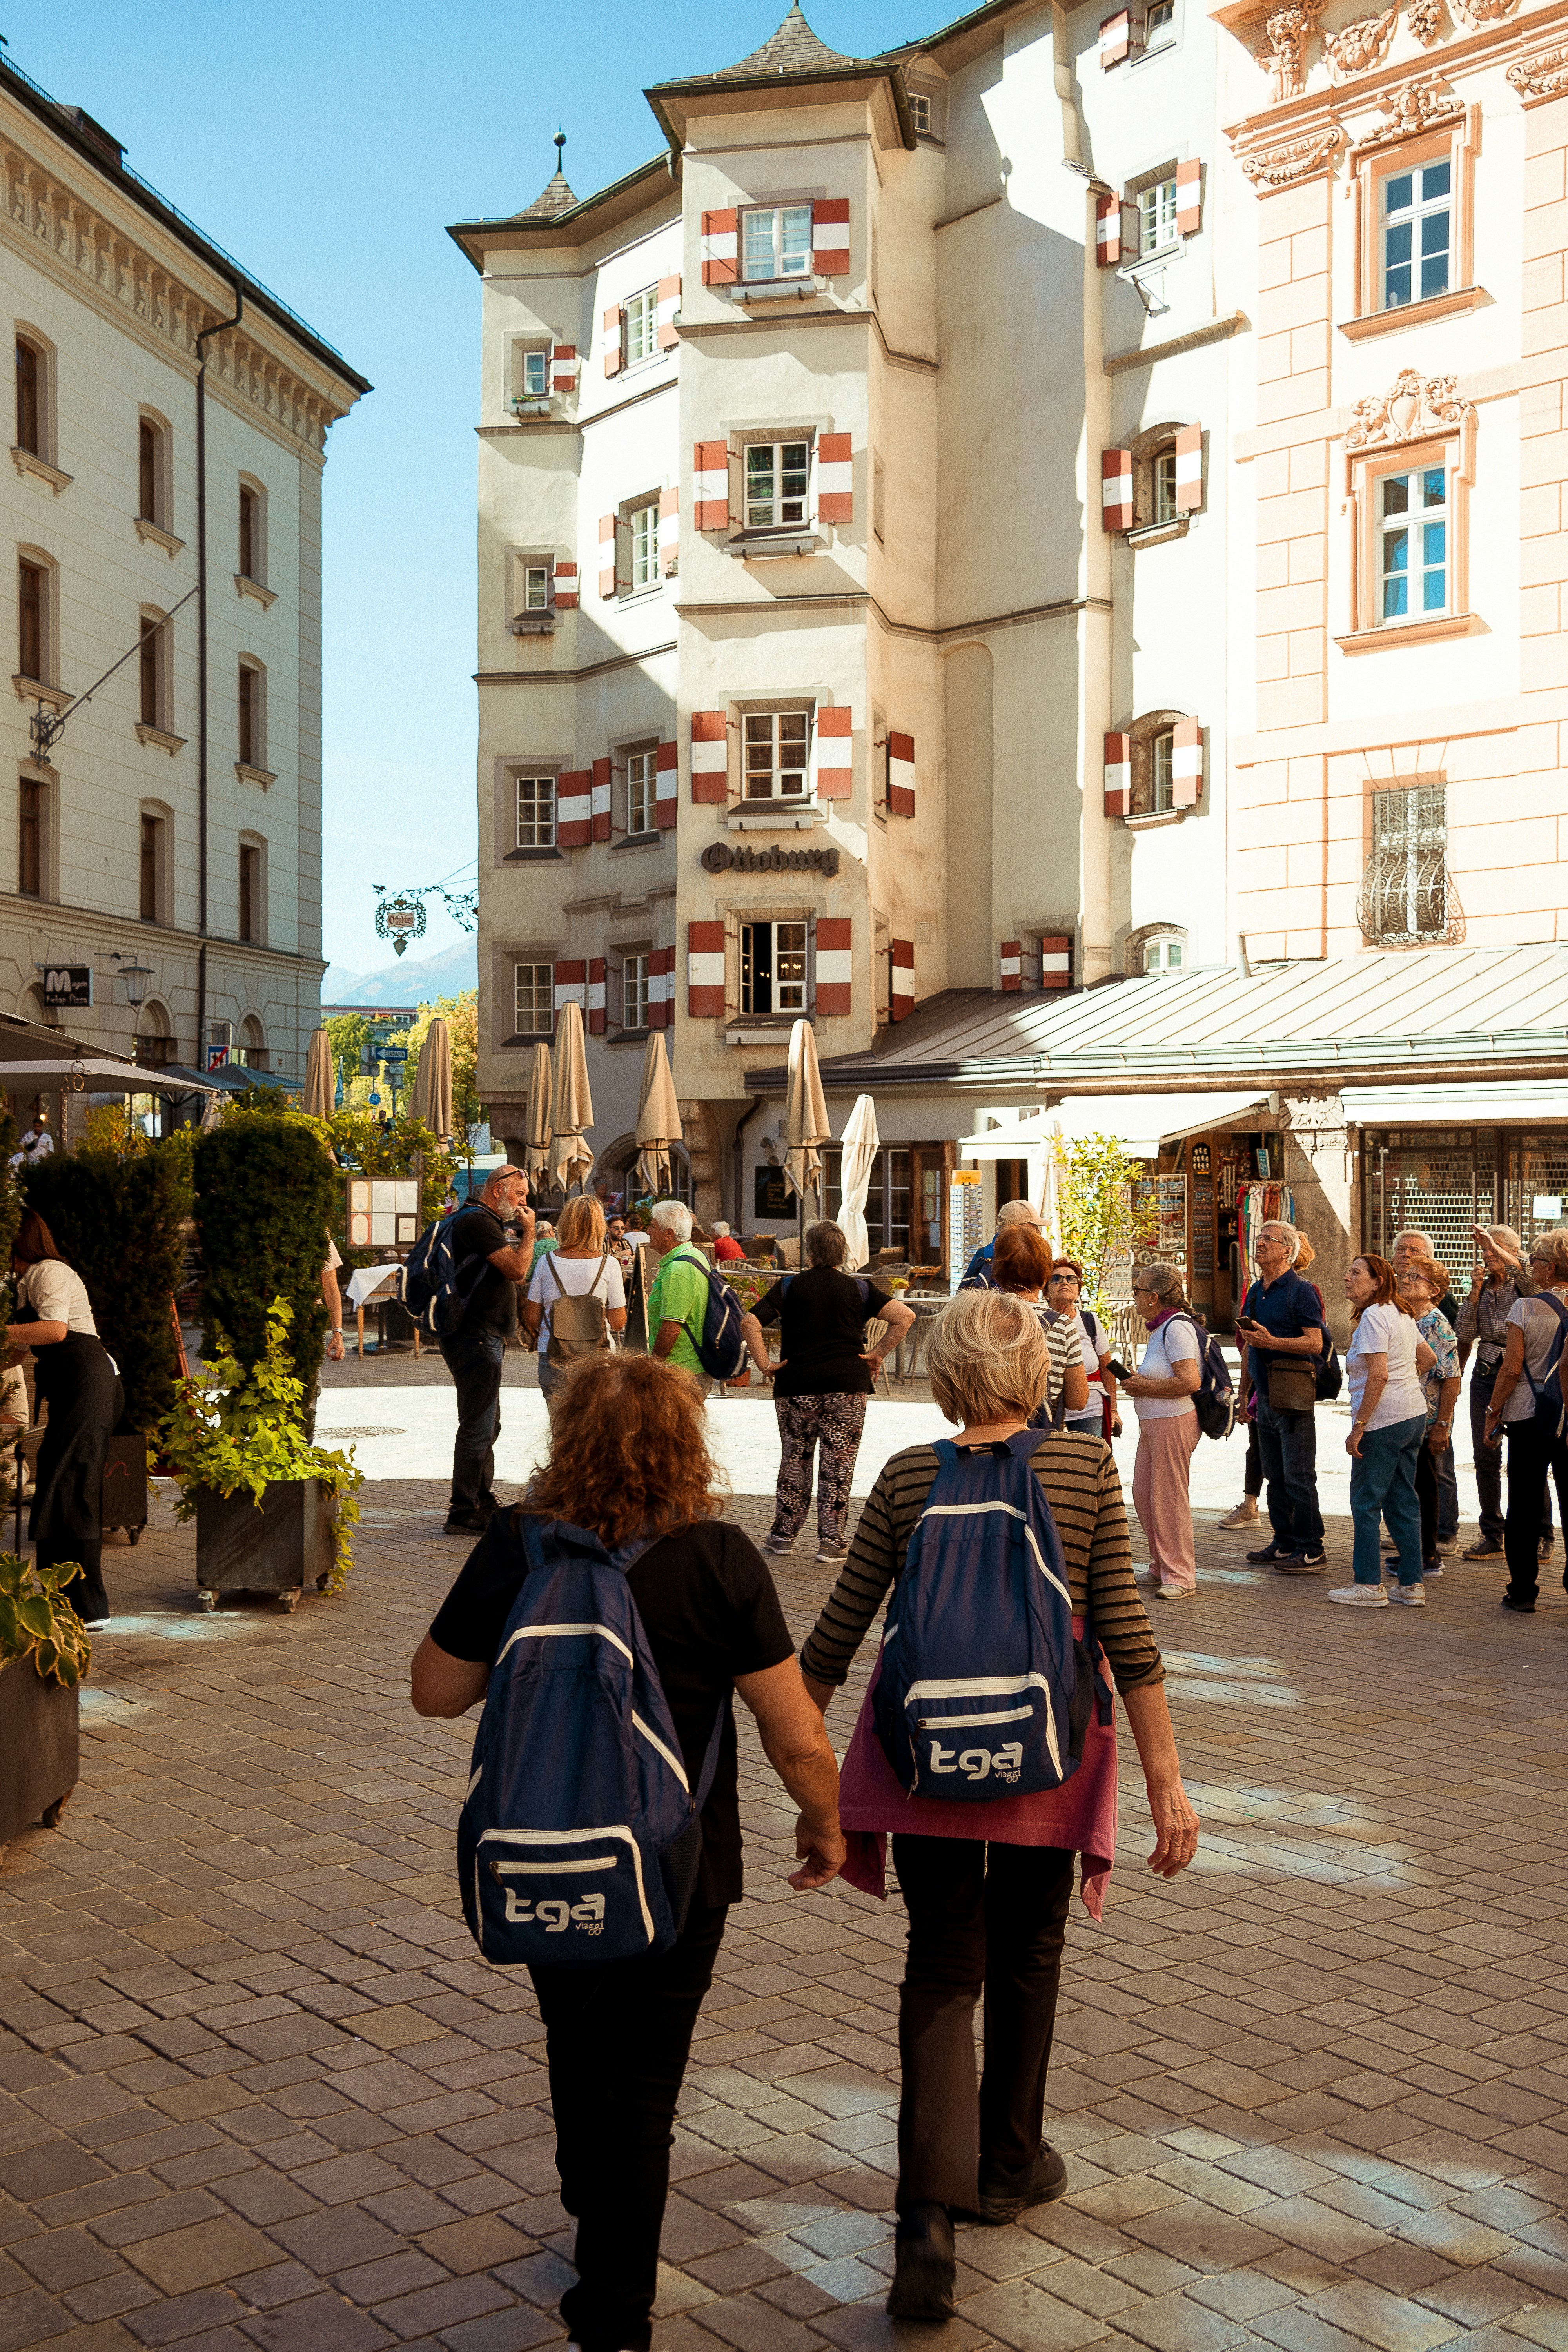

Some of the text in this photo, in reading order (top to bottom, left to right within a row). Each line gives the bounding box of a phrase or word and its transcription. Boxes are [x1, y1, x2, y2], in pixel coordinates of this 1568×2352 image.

[701, 842, 840, 878] Ottoburg
[929, 1740, 1023, 1780] tga
[995, 1768, 1021, 1783] viaggi
[504, 1887, 606, 1932] tga
[575, 1920, 604, 1935] viaggi
